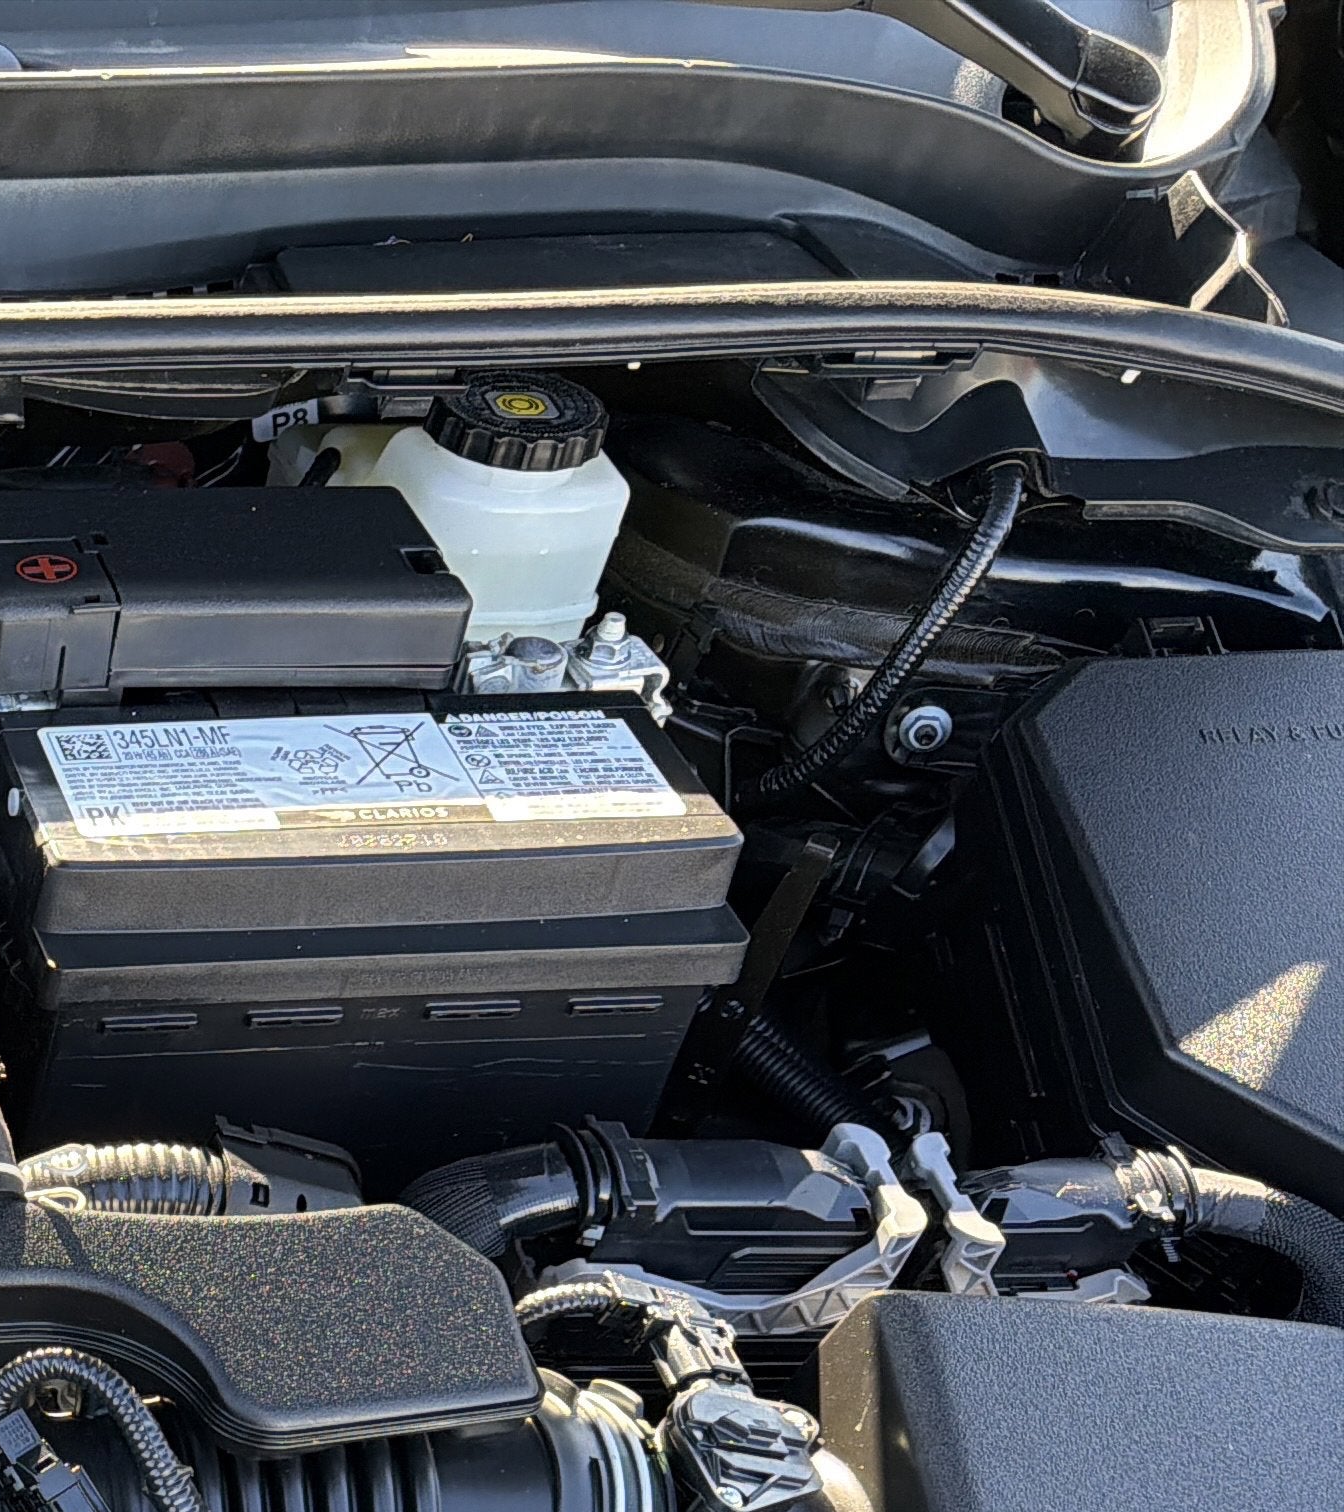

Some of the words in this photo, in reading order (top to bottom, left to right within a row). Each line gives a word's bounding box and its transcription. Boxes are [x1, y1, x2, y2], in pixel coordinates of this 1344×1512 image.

[459, 710, 606, 722] DANGER/POISON
[112, 725, 231, 749] 345LN1-MF
[1198, 726, 1277, 745] RELAY
[1310, 723, 1344, 741] FU
[395, 780, 432, 793] Pb
[358, 807, 448, 820] CLARIOS
